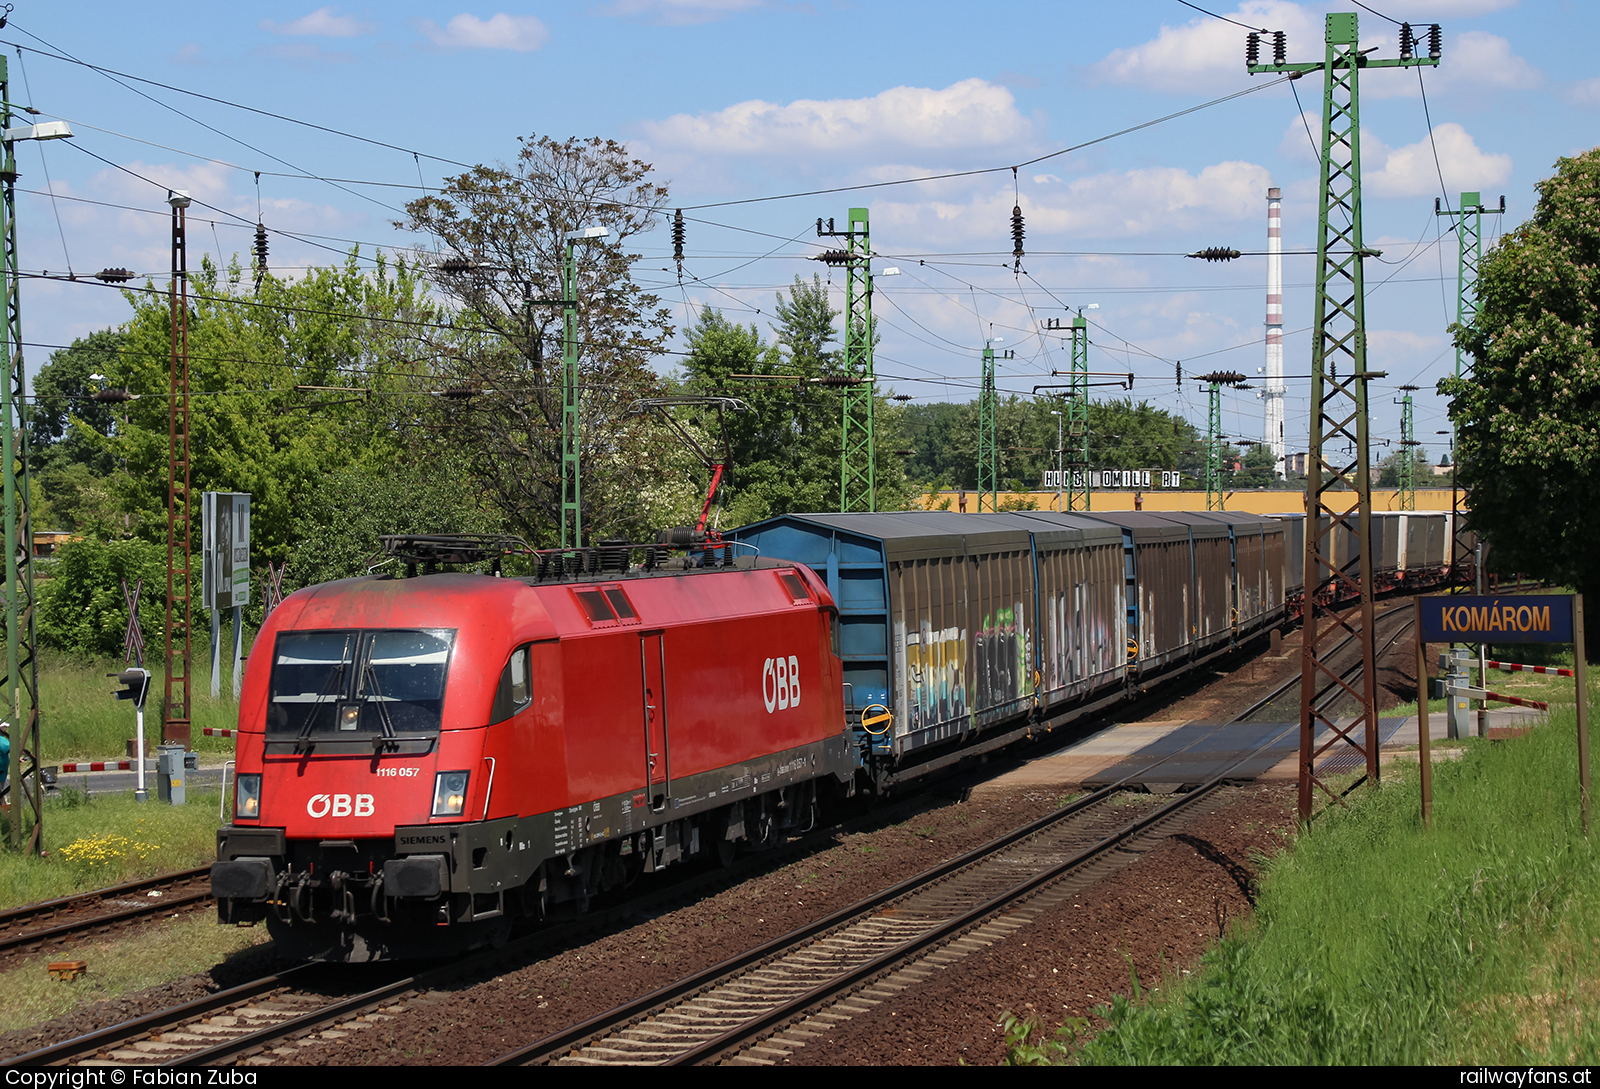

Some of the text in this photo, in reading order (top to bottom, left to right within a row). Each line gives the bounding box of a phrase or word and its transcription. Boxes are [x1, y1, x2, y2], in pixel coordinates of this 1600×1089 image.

[1442, 600, 1550, 632] KOMÁROM
[762, 654, 801, 715] ÖBB
[376, 767, 420, 777] 1116 057
[306, 793, 375, 818] ÖBB
[400, 835, 446, 845] SIEMENS
